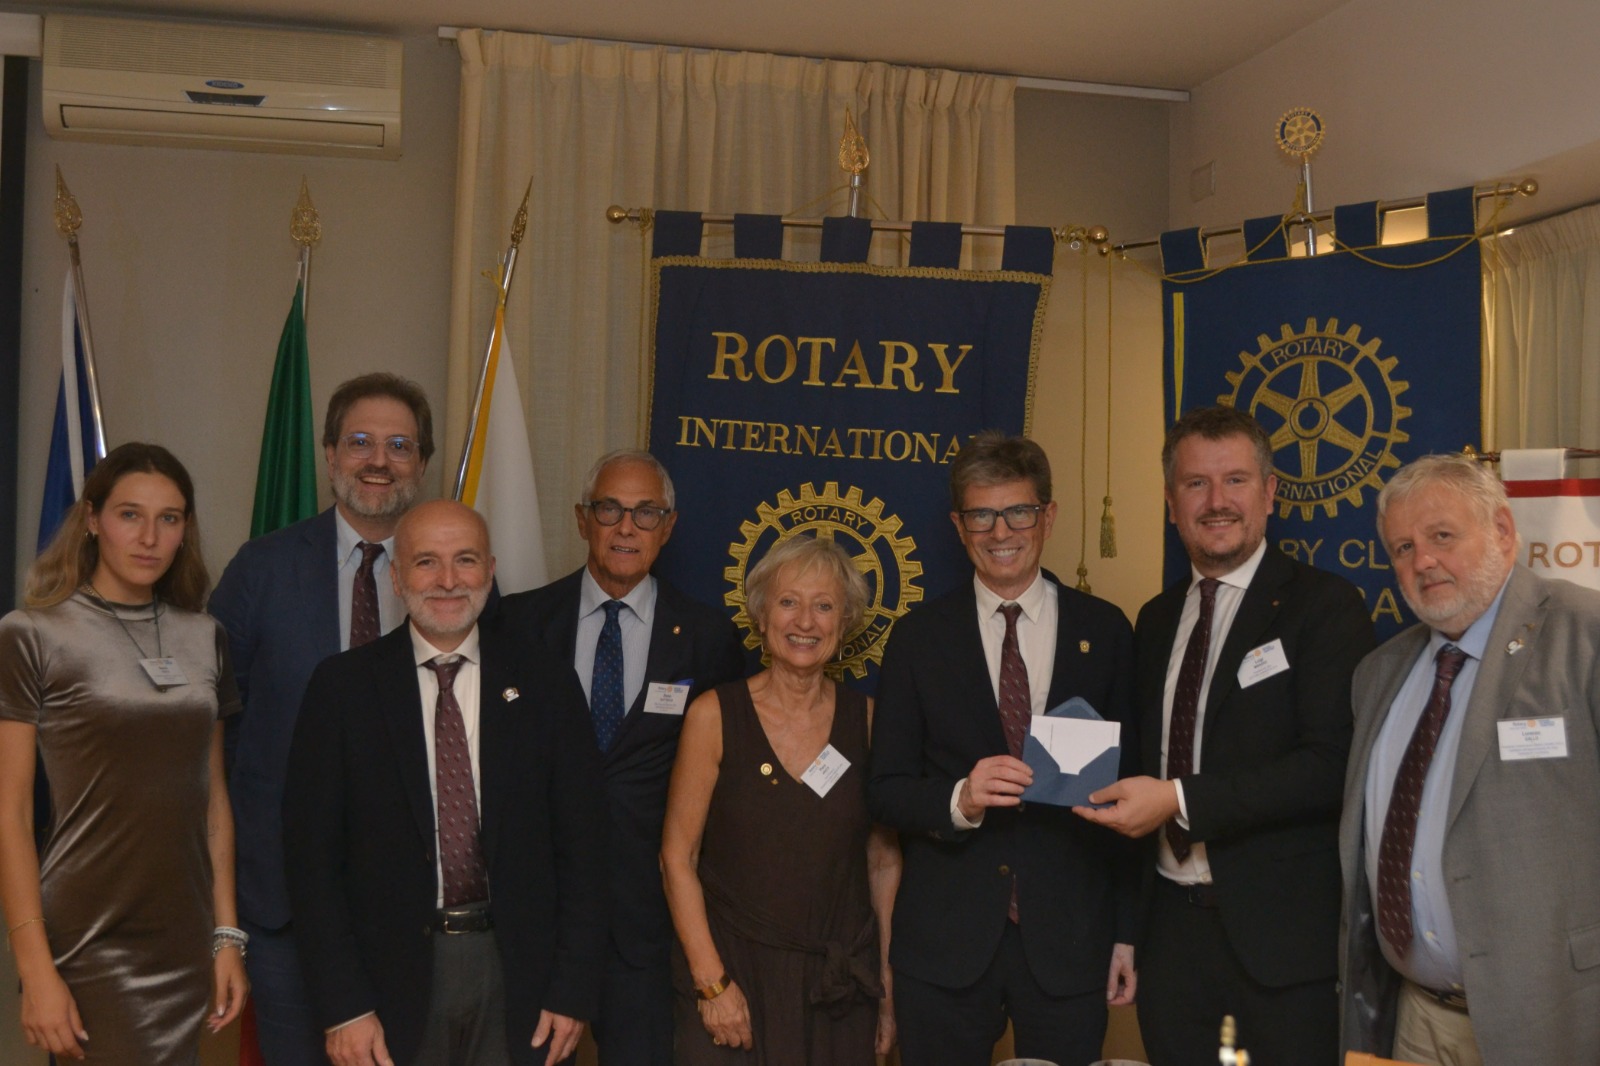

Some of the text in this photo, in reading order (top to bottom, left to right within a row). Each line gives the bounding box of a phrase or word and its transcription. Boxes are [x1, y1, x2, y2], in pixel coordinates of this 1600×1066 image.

[707, 331, 973, 394] ROTARY
[1270, 337, 1351, 365] ROTARY
[676, 415, 976, 464] INTERNATIONA
[1277, 449, 1383, 499] RNATIONAL
[791, 506, 868, 530] ROTARY
[1280, 538, 1393, 570] RY CL
[1528, 541, 1600, 569] ROT
[843, 623, 887, 658] ONAL
